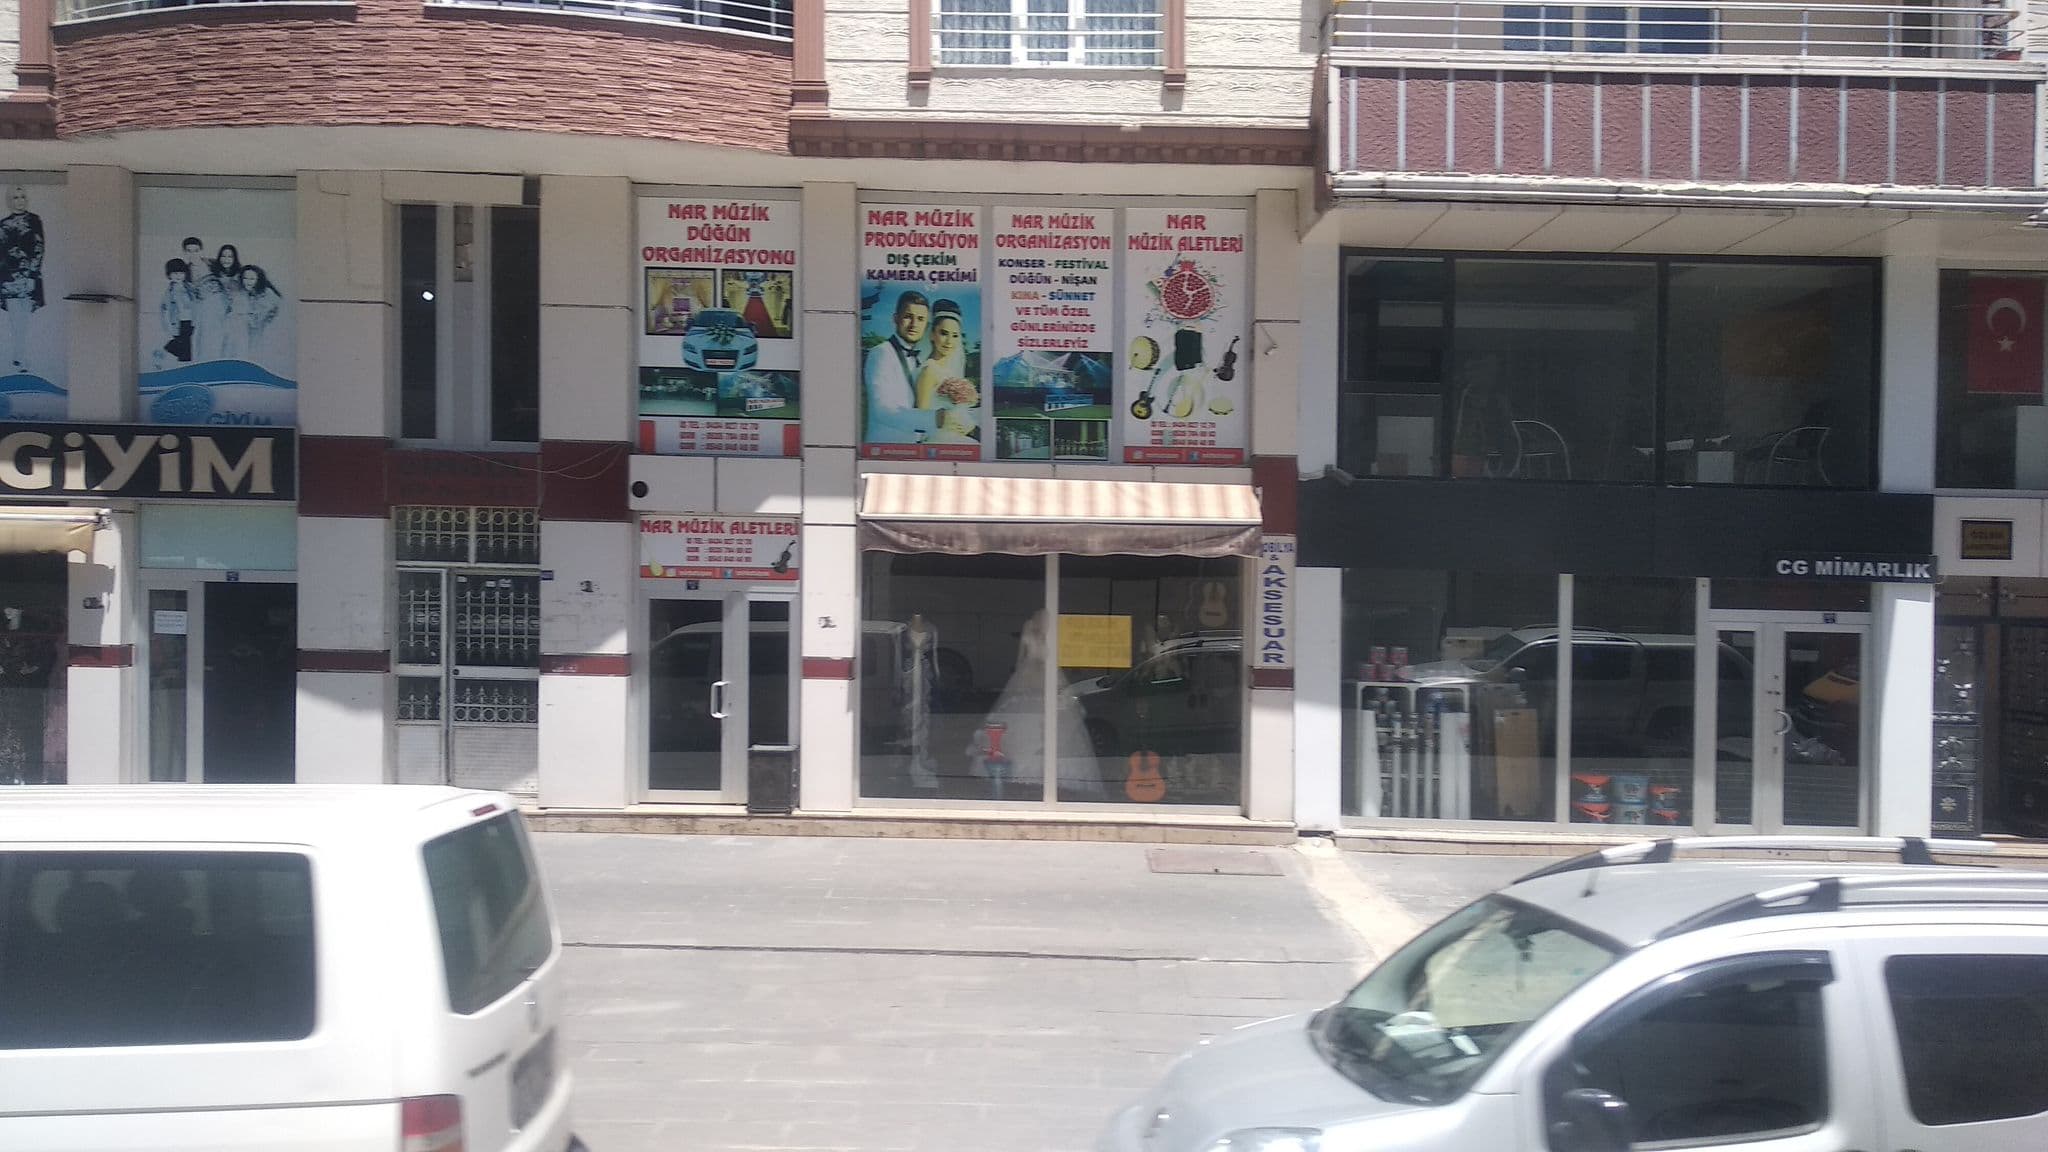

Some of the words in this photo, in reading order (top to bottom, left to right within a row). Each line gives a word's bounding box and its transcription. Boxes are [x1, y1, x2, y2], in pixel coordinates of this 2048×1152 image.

[668, 203, 707, 220] NAR
[713, 202, 770, 221] MÜZİK
[868, 210, 908, 227] NAR
[915, 208, 975, 227] MÜZİK
[1012, 214, 1043, 230] NAR
[1048, 213, 1095, 229] MÜZİK
[1167, 214, 1206, 230] NAR
[687, 223, 750, 242] DÜĞÜN
[864, 229, 979, 249] PRODÜKSÜYON
[995, 232, 1111, 250] ORGANİZASYON
[1128, 232, 1173, 251] MÜZİK
[1177, 234, 1243, 252] ALETLERİ
[642, 245, 796, 265] ORGANİZASYONU
[887, 253, 910, 268] DIŞ
[913, 252, 957, 268] ÇEKİM
[998, 258, 1046, 269] KONSER
[1055, 258, 1109, 270] FESTİVAL
[867, 269, 926, 281] KAMERA
[928, 268, 977, 284] ÇEKİMİ
[1009, 272, 1051, 285] DÜĞÜN
[1061, 273, 1097, 286] NİŞAN
[1011, 291, 1039, 300] KINA
[1048, 289, 1096, 301] SÜNNET
[1016, 307, 1031, 316] VE
[1033, 304, 1058, 316] TÜM
[1061, 305, 1091, 317] ÖZEL
[1010, 320, 1096, 333] GÜNLERİNİZDE
[1017, 336, 1088, 349] SİZLERLEYİZ
[640, 519, 673, 534] NAR
[678, 518, 725, 534] MÜZİK
[731, 520, 799, 535] ALETLERİ
[1776, 558, 1809, 575] CG
[1815, 556, 1931, 579] MİMARLIK
[1262, 564, 1288, 664] AKSESUAR
